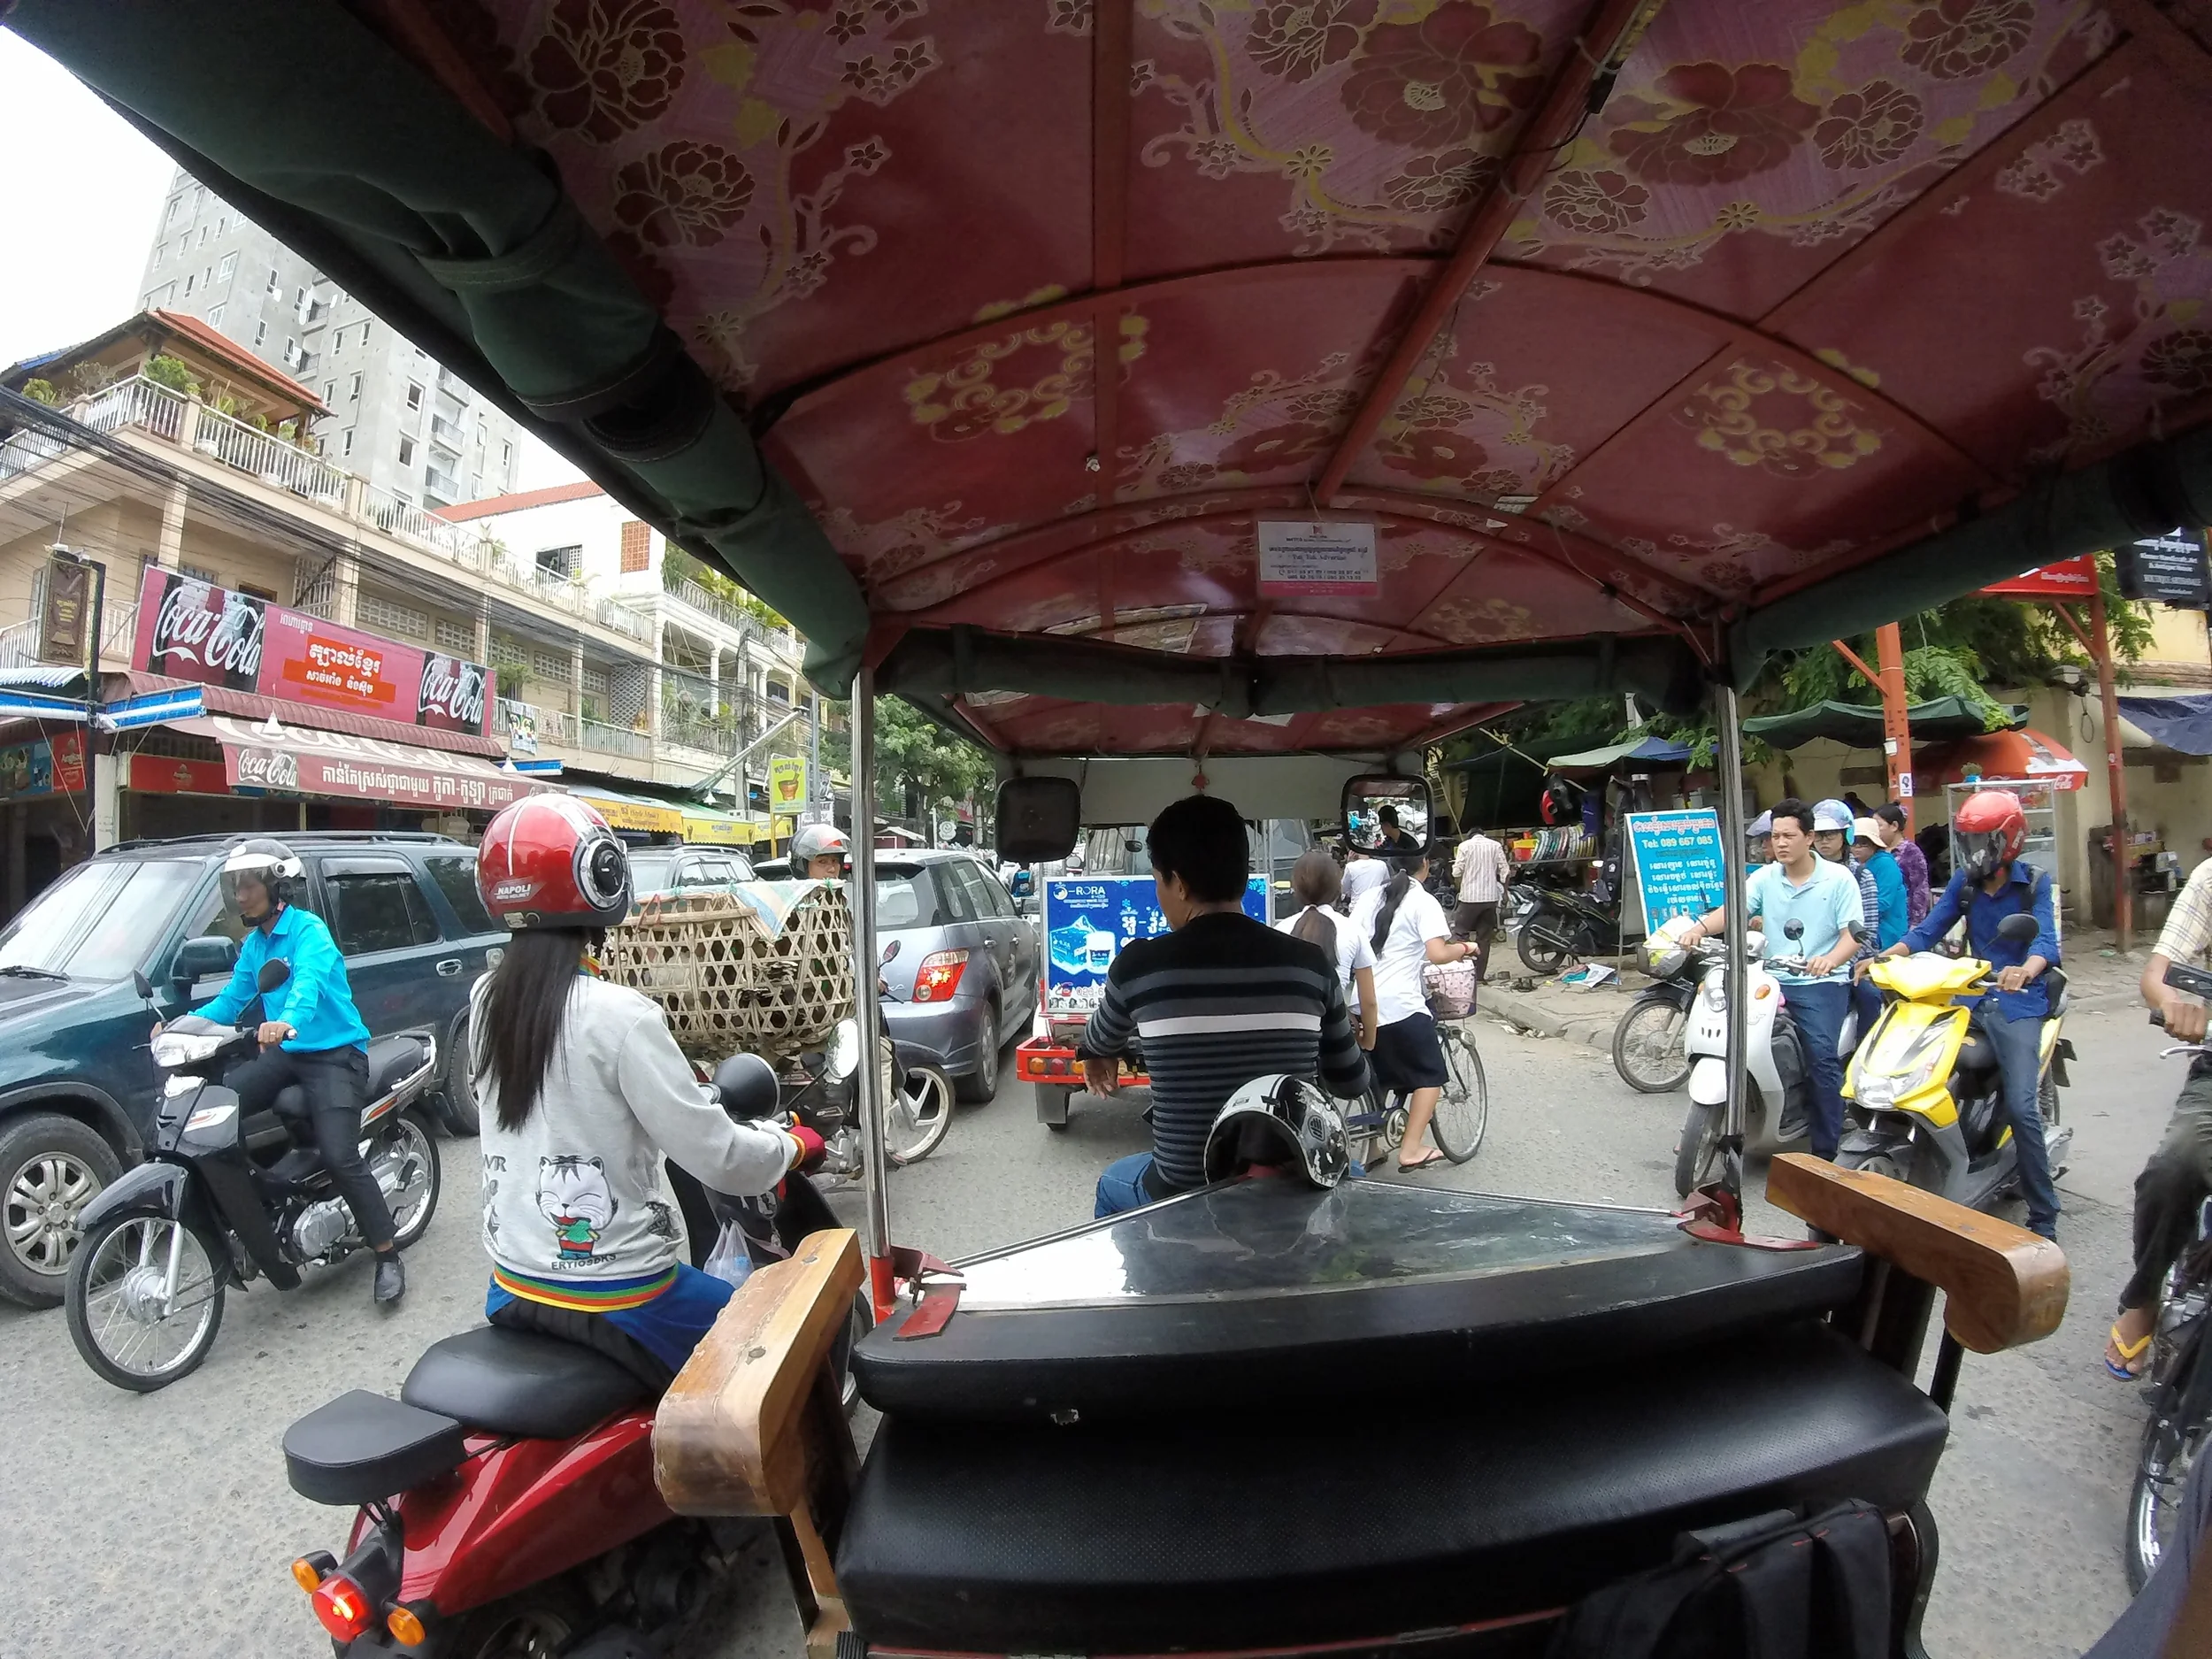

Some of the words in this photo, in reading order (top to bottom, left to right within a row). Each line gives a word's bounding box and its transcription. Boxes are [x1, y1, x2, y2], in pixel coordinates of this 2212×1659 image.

[152, 587, 265, 676] Coca-Cola
[418, 657, 486, 725] Coca-Cola
[238, 748, 297, 787] Coca-Cola
[497, 883, 532, 895] NAPOLI
